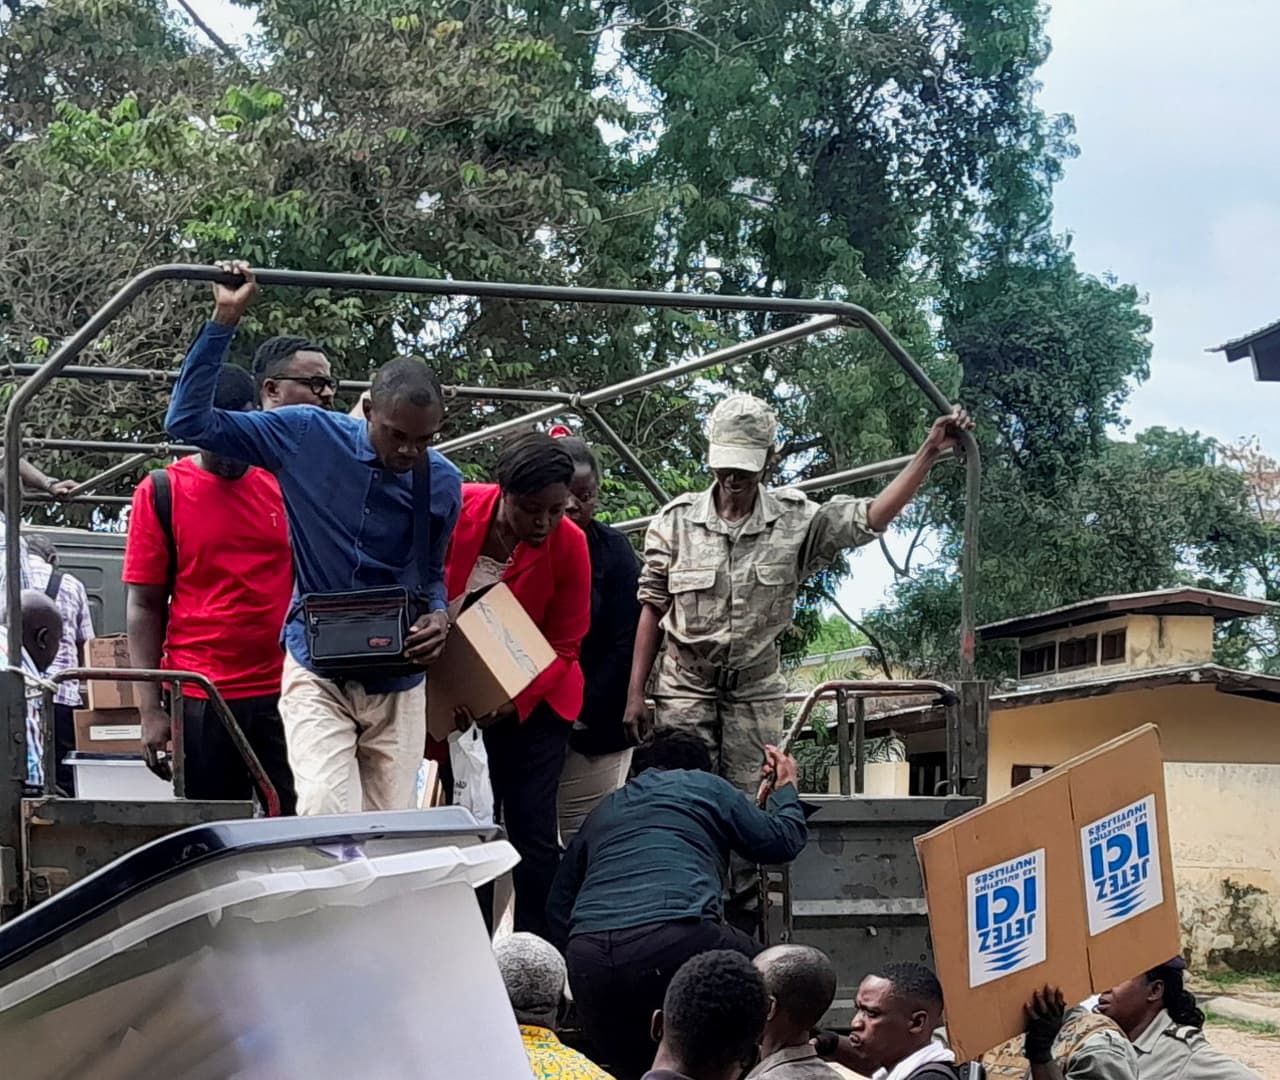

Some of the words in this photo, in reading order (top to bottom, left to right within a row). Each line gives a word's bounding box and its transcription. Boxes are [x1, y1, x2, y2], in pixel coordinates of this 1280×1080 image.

[1090, 821, 1150, 882] ICI
[975, 875, 1037, 932] ICI
[1095, 857, 1150, 902] JETEZ
[978, 913, 1036, 953] JETEZ
